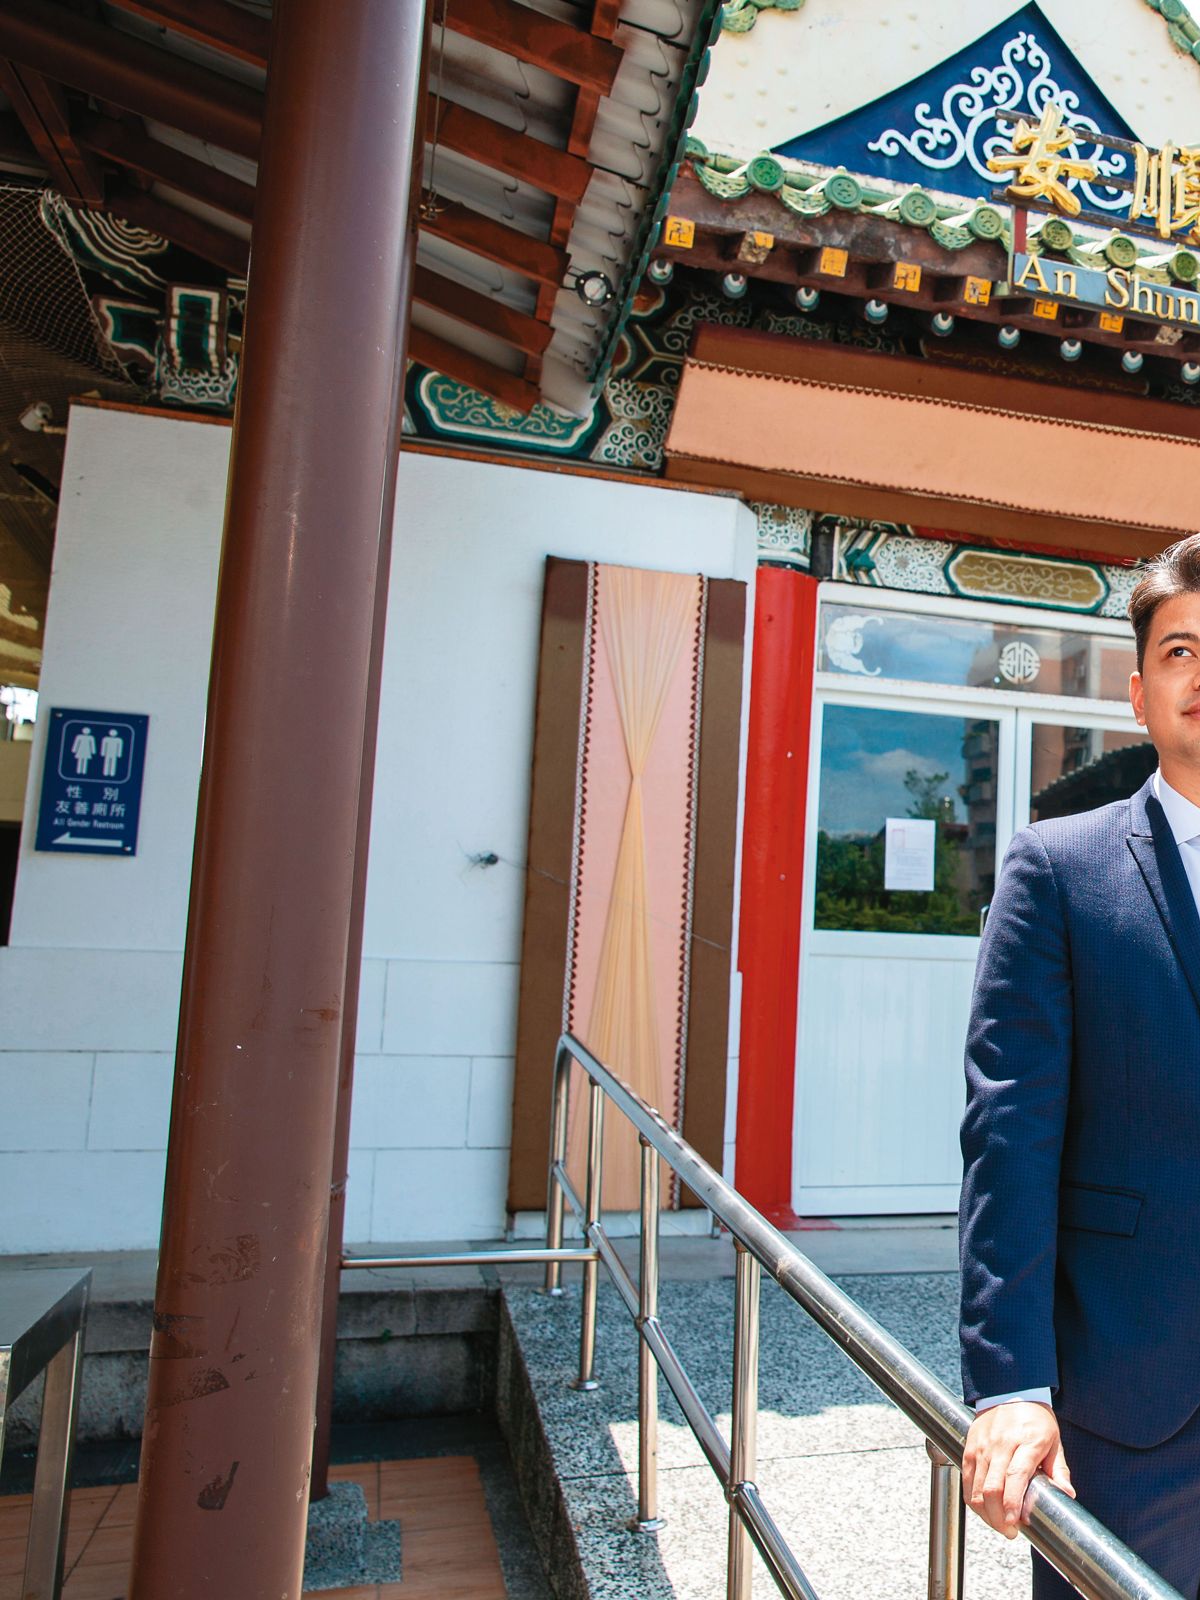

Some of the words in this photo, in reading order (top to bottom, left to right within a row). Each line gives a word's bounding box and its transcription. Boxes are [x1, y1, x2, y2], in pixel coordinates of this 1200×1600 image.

[1014, 254, 1078, 300] An
[1104, 266, 1199, 325] Shun
[55, 800, 126, 817] 友善廁所
[53, 817, 66, 826] All
[66, 818, 90, 828] Gender
[93, 819, 124, 830] Restroom
